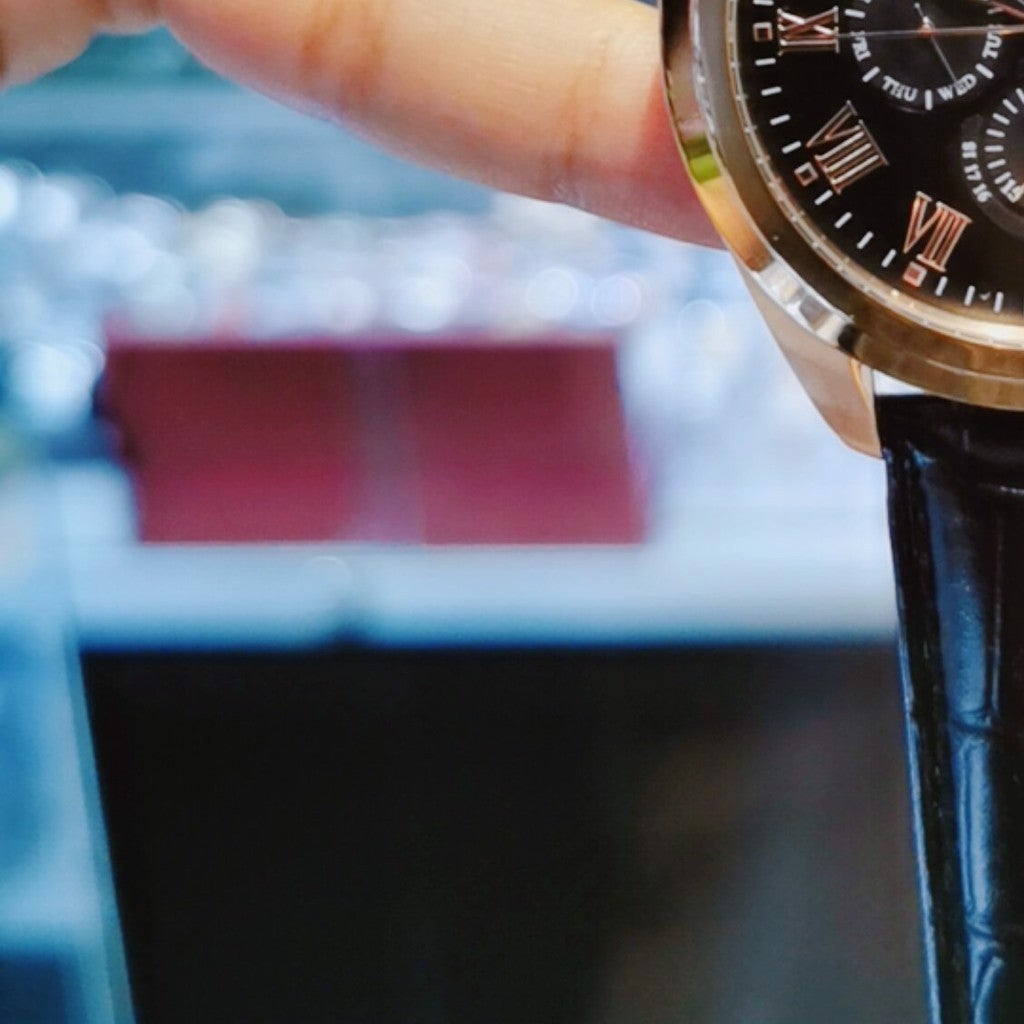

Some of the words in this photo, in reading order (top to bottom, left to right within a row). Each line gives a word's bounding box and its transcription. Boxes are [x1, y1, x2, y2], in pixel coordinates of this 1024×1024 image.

[778, 6, 840, 55] IX
[882, 75, 918, 102] THU
[937, 73, 977, 102] WED
[806, 100, 890, 195] VIII
[964, 164, 982, 181] 17
[972, 183, 992, 203] 16
[903, 191, 972, 272] VII
